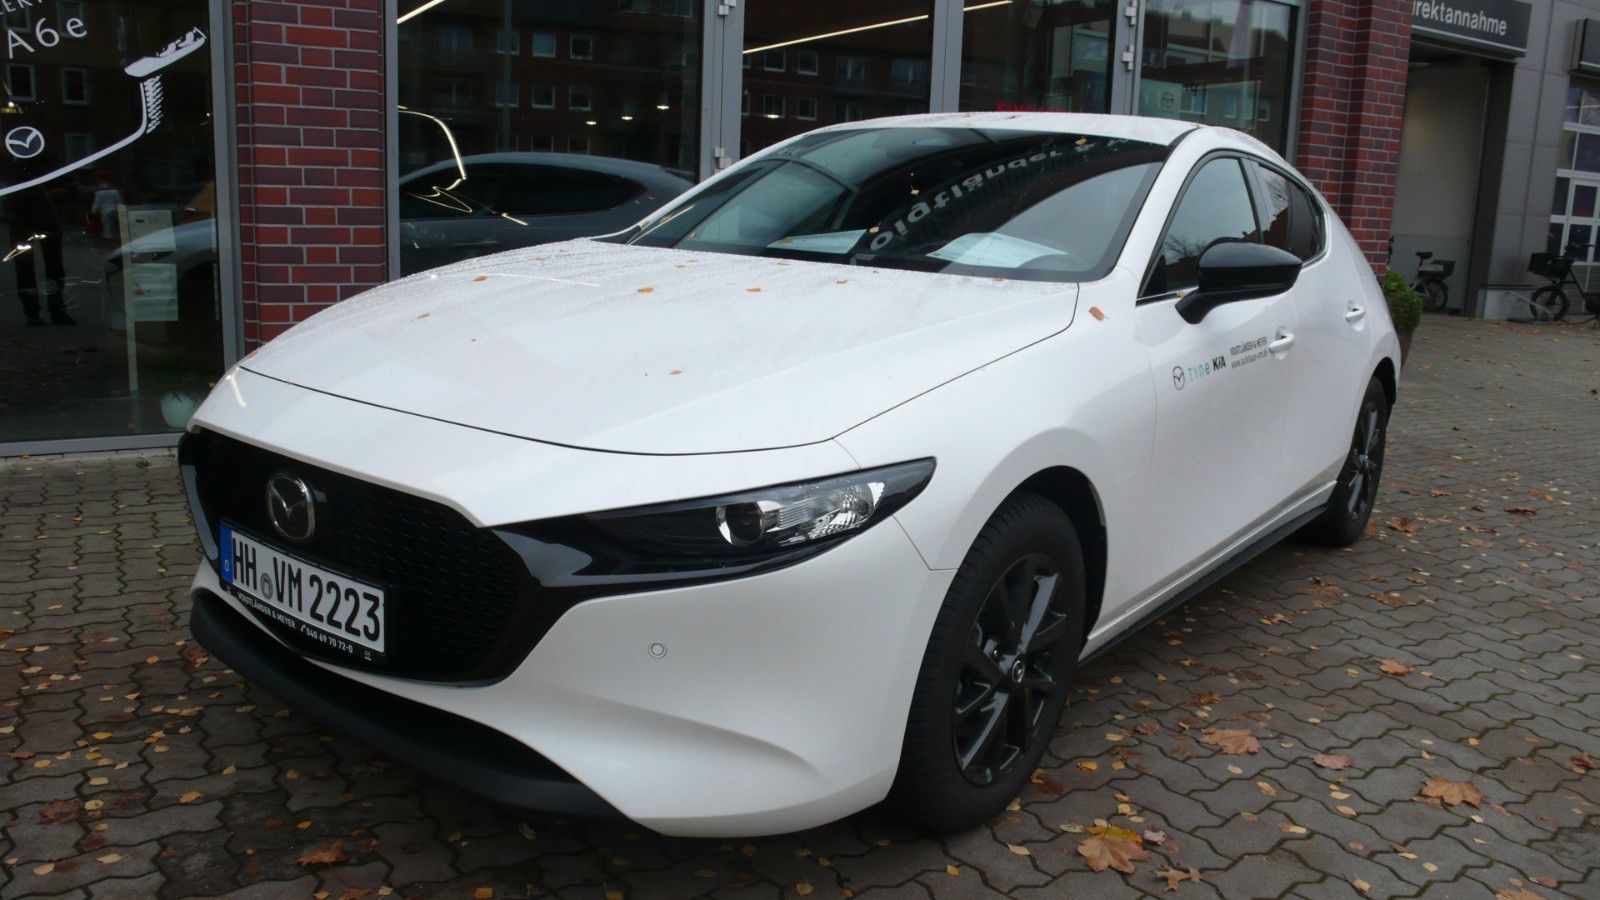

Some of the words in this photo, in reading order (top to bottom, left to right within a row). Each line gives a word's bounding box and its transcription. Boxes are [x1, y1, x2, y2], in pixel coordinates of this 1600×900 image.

[232, 537, 257, 591] HH
[272, 556, 304, 613] VM
[309, 573, 381, 642] 2223
[277, 613, 296, 629] MEYER
[306, 628, 318, 640] 040
[319, 633, 327, 644] 69
[328, 637, 337, 648] 70
